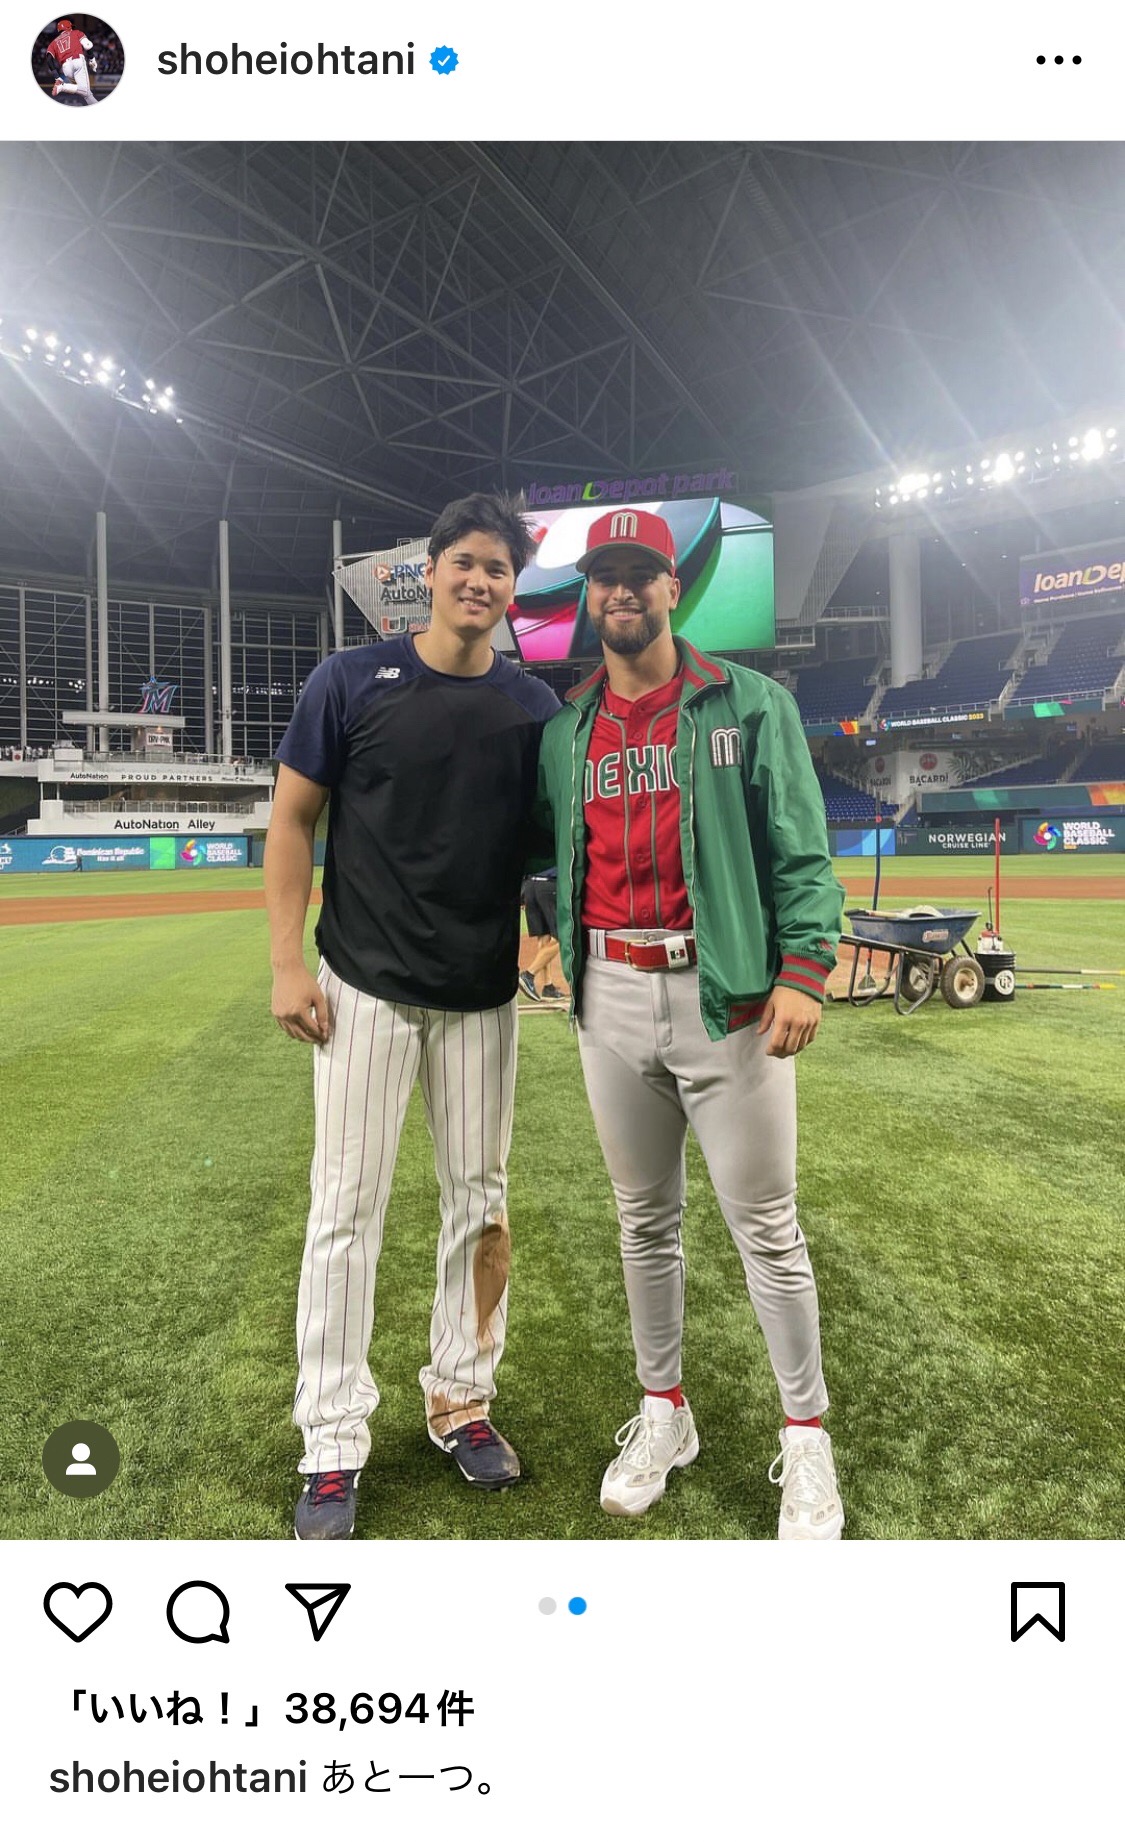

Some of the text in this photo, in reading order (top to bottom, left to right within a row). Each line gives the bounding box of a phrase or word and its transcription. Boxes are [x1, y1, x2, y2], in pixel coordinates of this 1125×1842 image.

[529, 467, 733, 505] loanDepot park
[890, 720, 912, 728] WORLD
[912, 718, 942, 726] BASEBALL
[942, 714, 968, 723] CLASSIC
[162, 774, 213, 782] PARTNERS
[114, 819, 216, 831] AutoNation Alley
[1063, 821, 1100, 830] WORLD
[928, 832, 1006, 843] NORWEGIAN
[1063, 829, 1115, 837] BASEBALL
